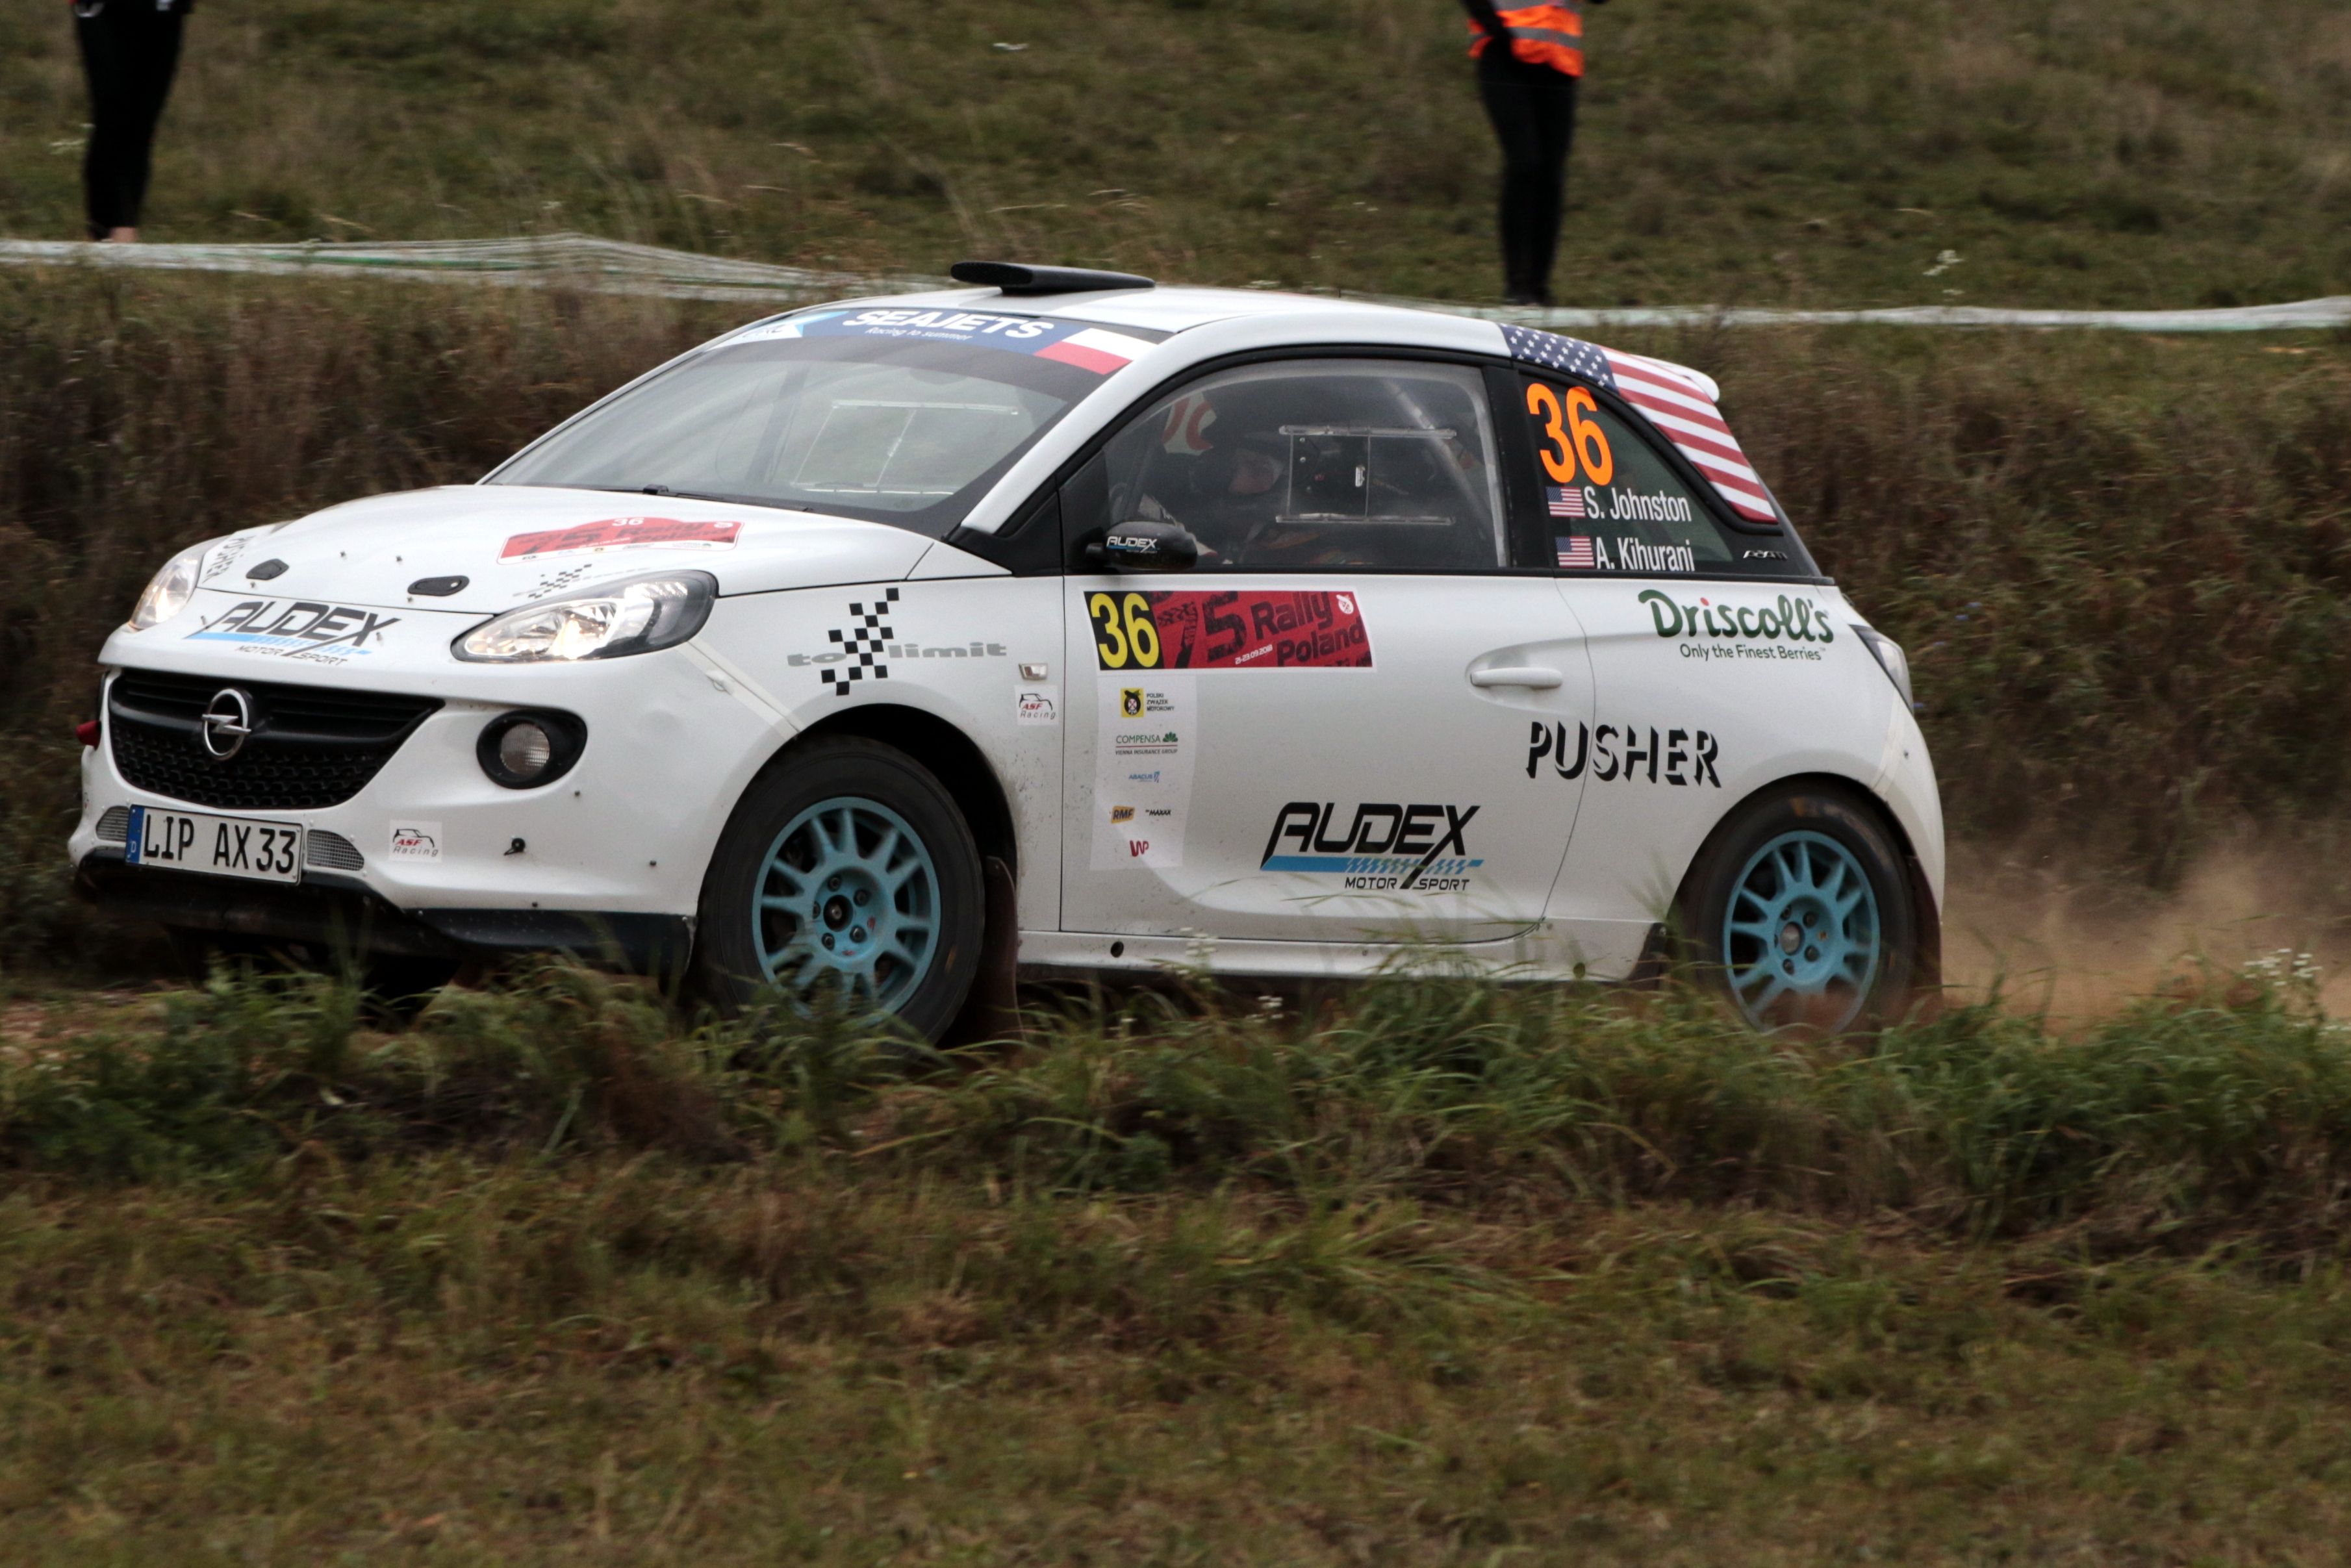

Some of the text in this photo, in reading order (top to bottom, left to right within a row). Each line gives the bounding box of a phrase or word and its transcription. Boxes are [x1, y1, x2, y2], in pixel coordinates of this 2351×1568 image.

[843, 310, 1054, 338] SEAJETS
[1527, 383, 1614, 486] 36
[1584, 487, 1692, 522] S. Johnston
[612, 518, 644, 527] 36
[1106, 536, 1158, 553] AUDEX
[1597, 538, 1696, 572] A. Kihurani
[183, 601, 402, 657] AUDEX
[1091, 593, 1160, 668] 36
[1156, 590, 1247, 669] 75
[1251, 591, 1334, 640] Rally
[1638, 589, 1834, 643] Driscoll's
[235, 645, 348, 666] MOTOR SPORT
[787, 642, 1007, 666] to limit
[1277, 615, 1366, 667] Poland
[1680, 643, 1821, 661] Only the Finest Berries
[1020, 711, 1056, 720] Racing
[1115, 735, 1161, 744] COMPENSA
[1526, 720, 1722, 788] PUSHER
[1113, 809, 1134, 820] RMF
[144, 814, 194, 861] LIP
[393, 846, 439, 857] Racing
[1260, 802, 1481, 889] AUDEX
[1345, 877, 1470, 891] MOTOR SPORT
